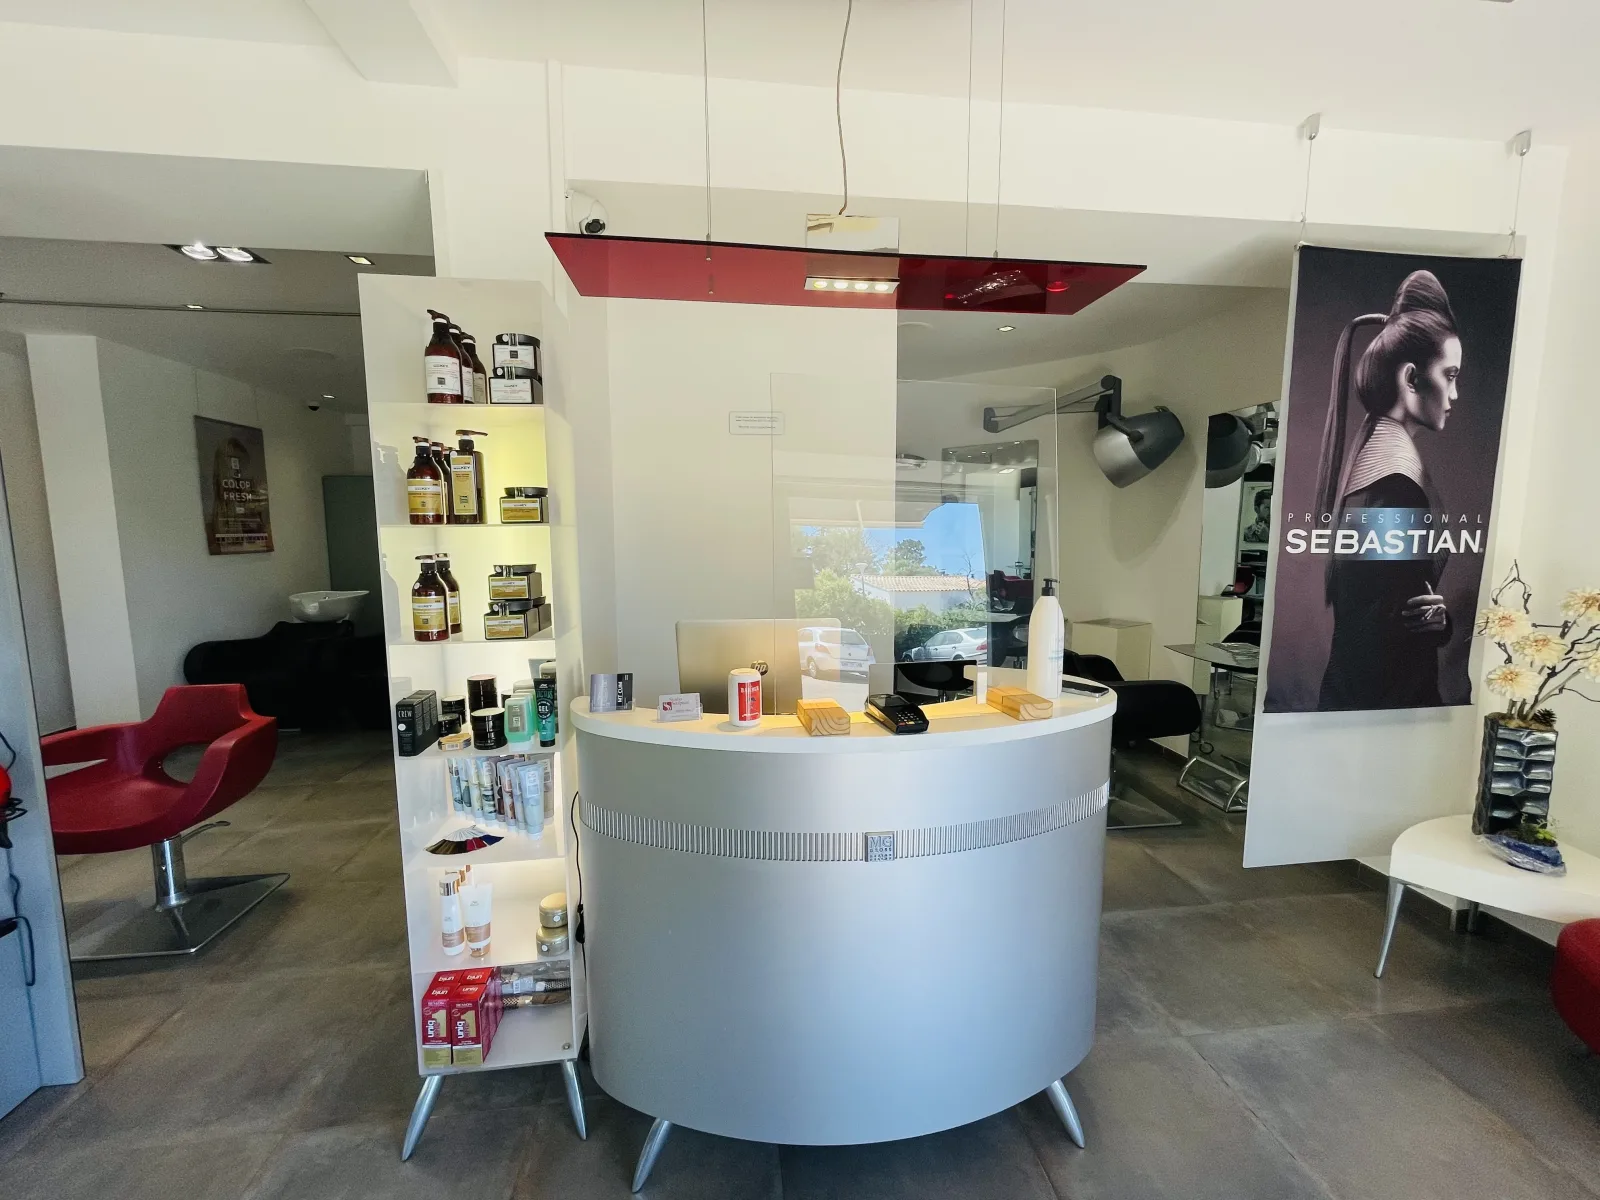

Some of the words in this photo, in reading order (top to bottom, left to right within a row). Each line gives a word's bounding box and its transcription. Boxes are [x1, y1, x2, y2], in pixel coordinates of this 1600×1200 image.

[223, 491, 252, 501] FRESH
[1287, 512, 1483, 524] PROFESSIONAL
[1285, 528, 1481, 555] SEBASTIAN
[398, 710, 413, 718] CREW
[425, 1020, 436, 1038] uniq
[454, 1021, 465, 1039] uniq
